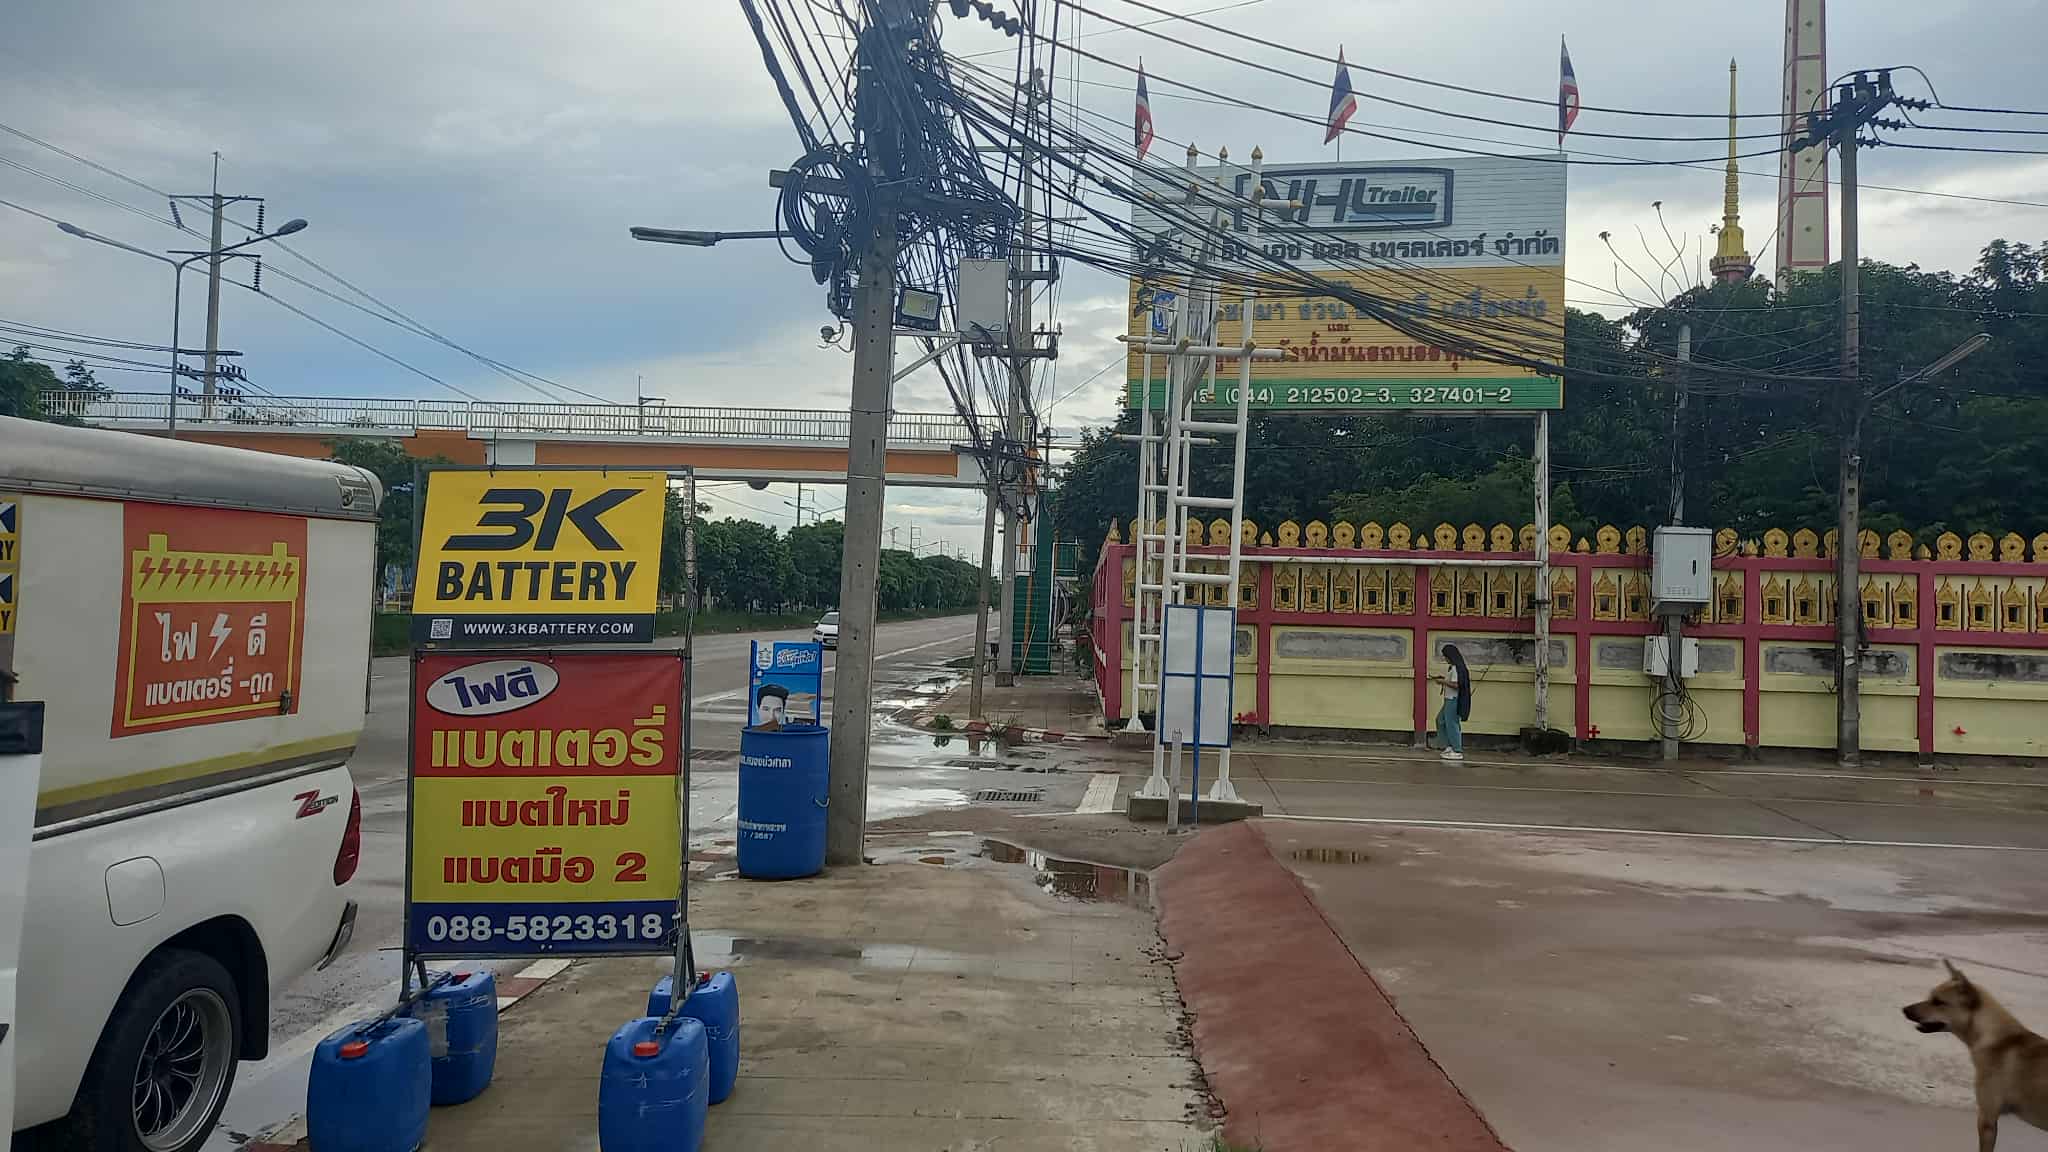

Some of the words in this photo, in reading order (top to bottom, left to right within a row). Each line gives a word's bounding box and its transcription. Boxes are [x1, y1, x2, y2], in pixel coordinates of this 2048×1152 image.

[1368, 186, 1438, 202] Trailer
[1495, 230, 1559, 256] จำกัด
[1410, 387, 1512, 402] 327401-2
[441, 489, 645, 550] 3K
[436, 561, 637, 600] BATTERY
[155, 612, 198, 662] ไฟ
[247, 613, 267, 656] ดี
[464, 622, 634, 634] WWW.3KBATTERY.COM
[145, 656, 233, 706] แบตเตอรี่
[444, 666, 539, 709] ไฟดี
[431, 705, 666, 768] แบตเตอรี่
[461, 786, 630, 827] แบตใหม่
[443, 847, 595, 884] แบตมือ
[615, 851, 647, 883] 2
[427, 914, 663, 942] 088-5823318
